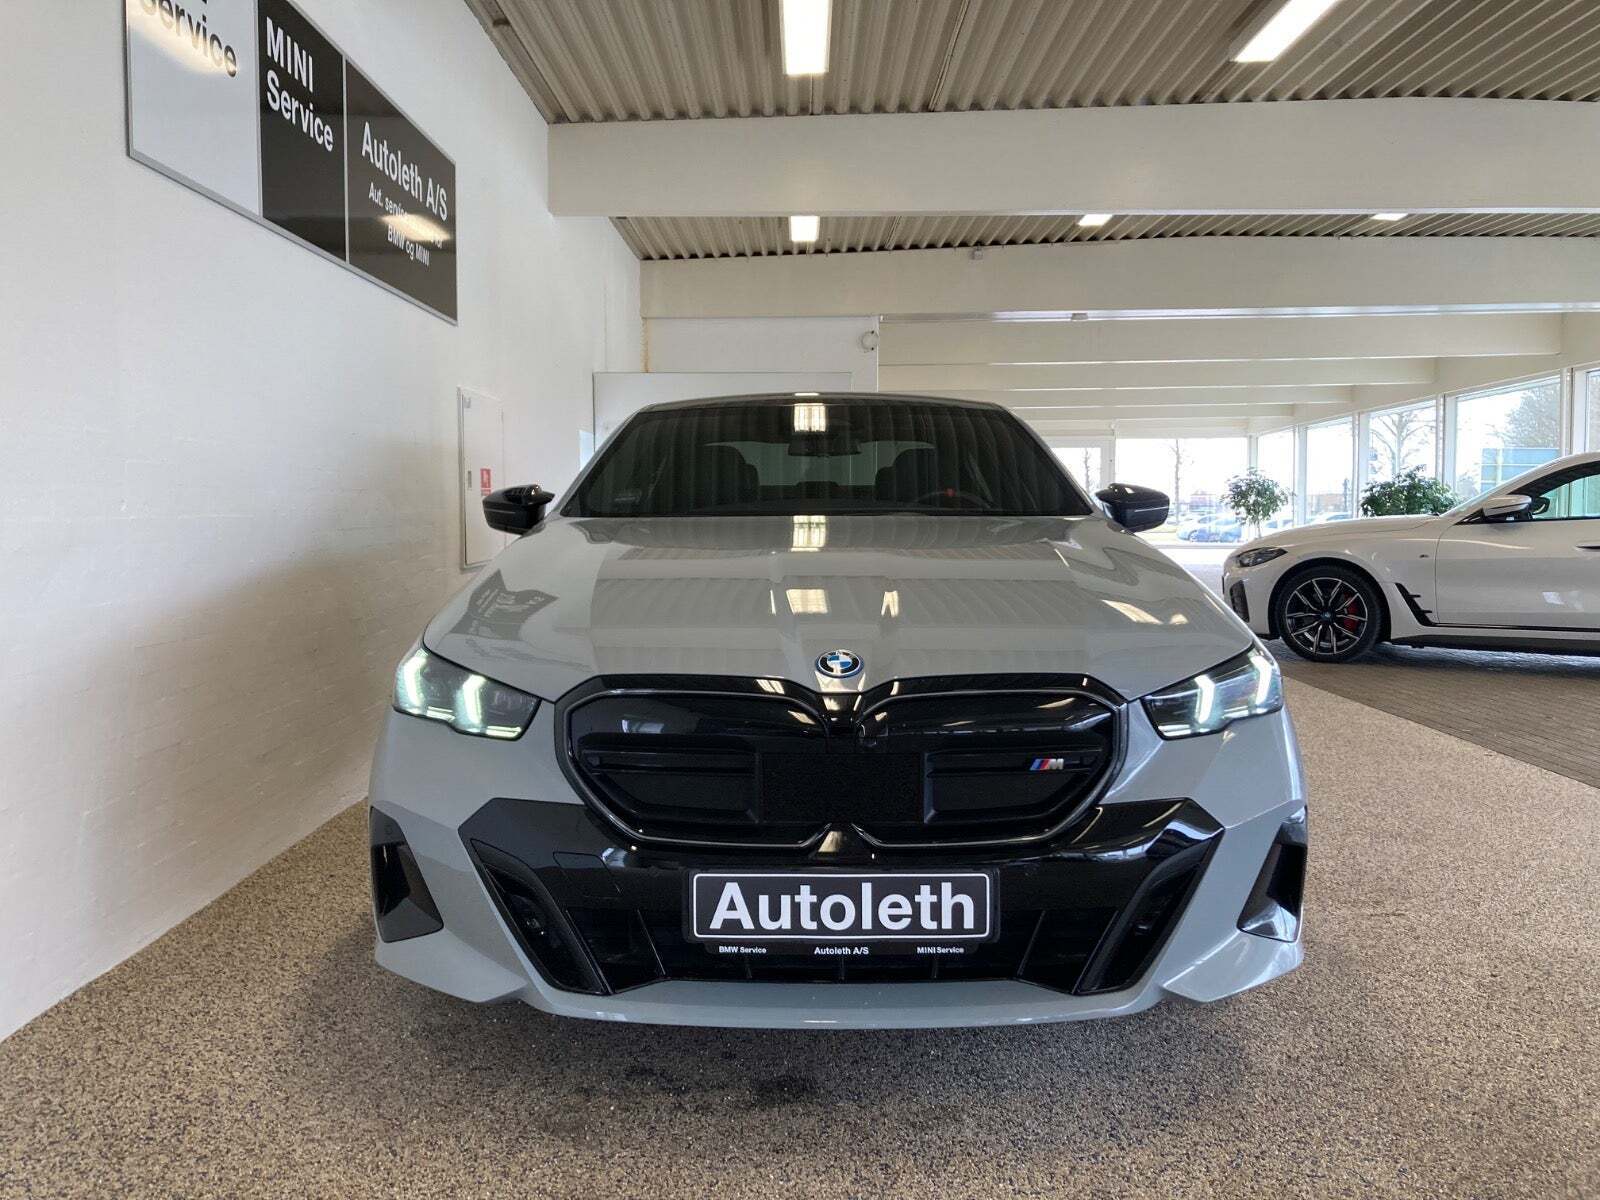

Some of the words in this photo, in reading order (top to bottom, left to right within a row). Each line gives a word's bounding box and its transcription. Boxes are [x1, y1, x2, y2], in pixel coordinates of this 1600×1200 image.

[266, 16, 314, 93] MINI
[266, 69, 334, 152] Service
[361, 121, 423, 203] Autoleth
[425, 177, 448, 222] A/S
[368, 181, 384, 208] Aut.
[387, 224, 406, 252] BMW
[405, 240, 415, 261] og
[415, 243, 430, 267] MINI
[709, 881, 975, 931] Autoleth
[718, 945, 739, 954] BMW
[739, 946, 767, 954] Service
[814, 946, 851, 955] Autoleth
[852, 946, 870, 955] A/S
[916, 946, 936, 954] MINI
[936, 946, 965, 954] Service
